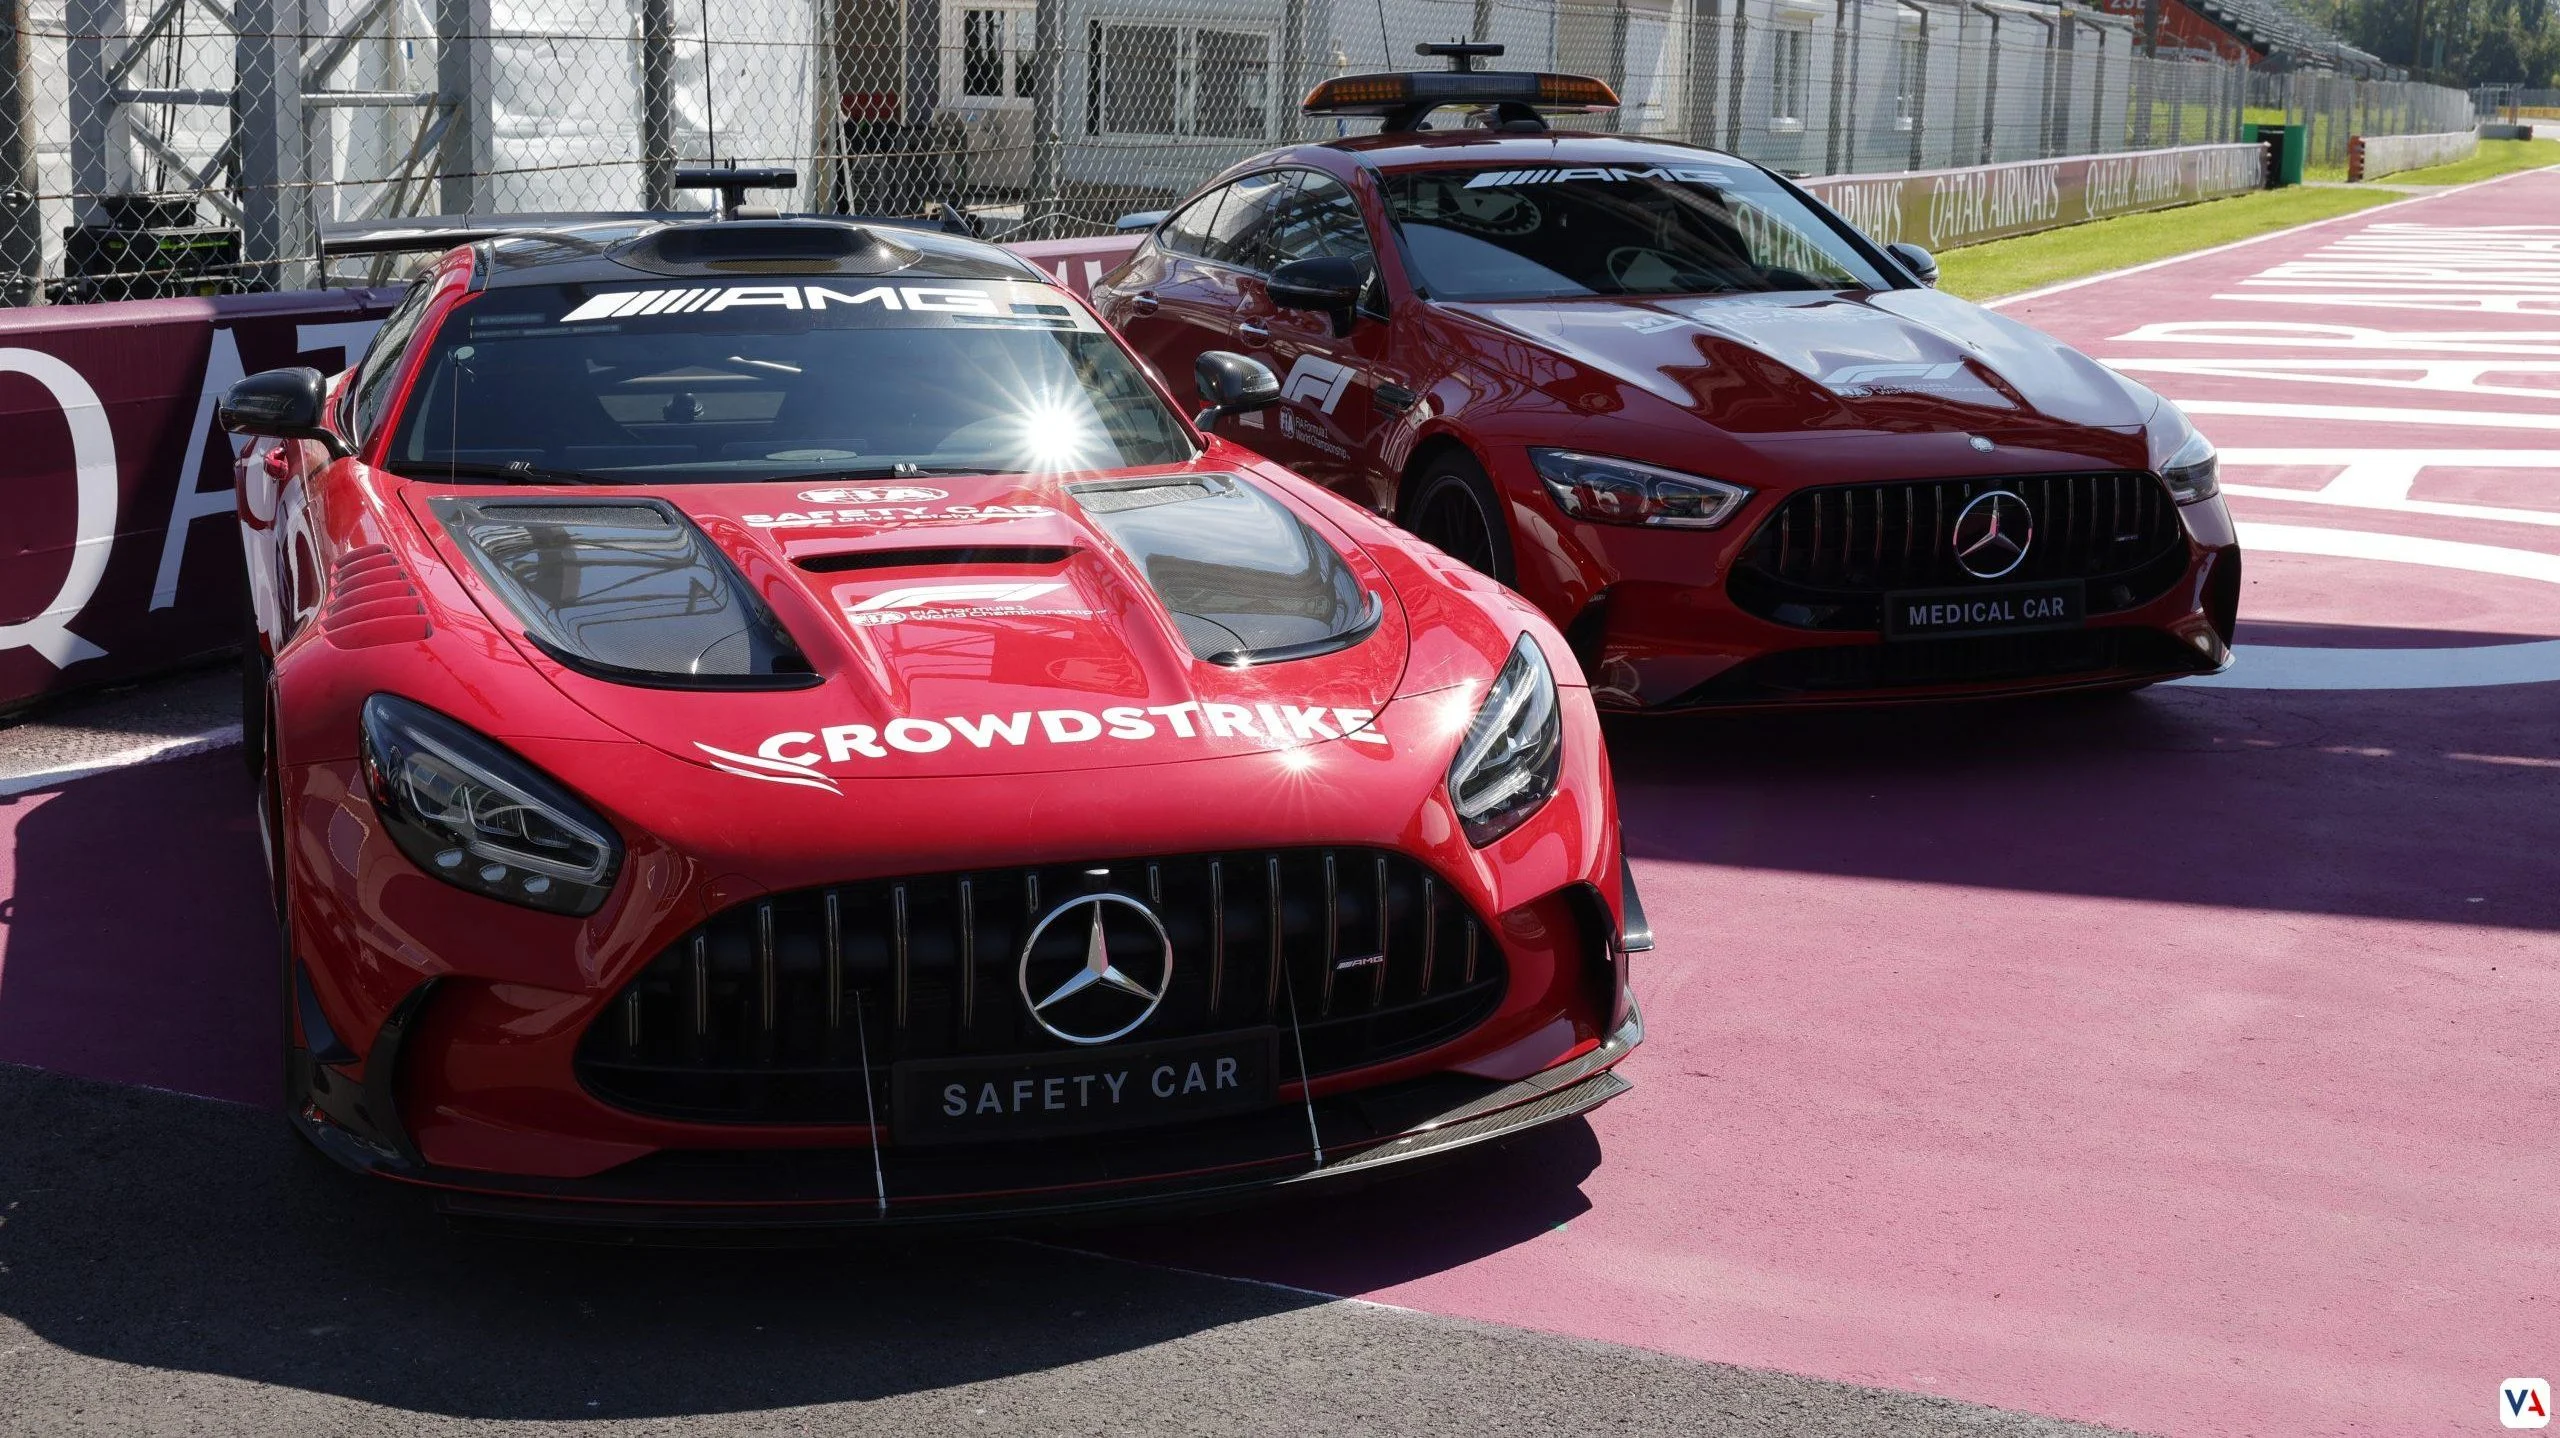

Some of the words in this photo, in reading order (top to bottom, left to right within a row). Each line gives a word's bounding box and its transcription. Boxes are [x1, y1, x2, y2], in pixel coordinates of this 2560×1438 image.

[1929, 171, 1986, 248] QATAR
[1988, 164, 2060, 229] AIRWAYS
[2085, 158, 2132, 218] QATAR
[2132, 152, 2182, 203] AIRWAYS
[1827, 181, 1903, 245] RWAYS
[741, 506, 930, 525] SAFETY
[945, 505, 1046, 515] CAR
[805, 487, 934, 502] FIA
[913, 612, 967, 621] World
[969, 609, 1094, 618] Championship
[942, 606, 1014, 614] Formula
[1908, 601, 2015, 626] MEDICAL
[2022, 597, 2065, 618] CAR
[758, 700, 1389, 767] CROWDSTRIKE
[943, 1070, 1129, 1117] SAFETY
[1151, 1057, 1240, 1099] CAR
